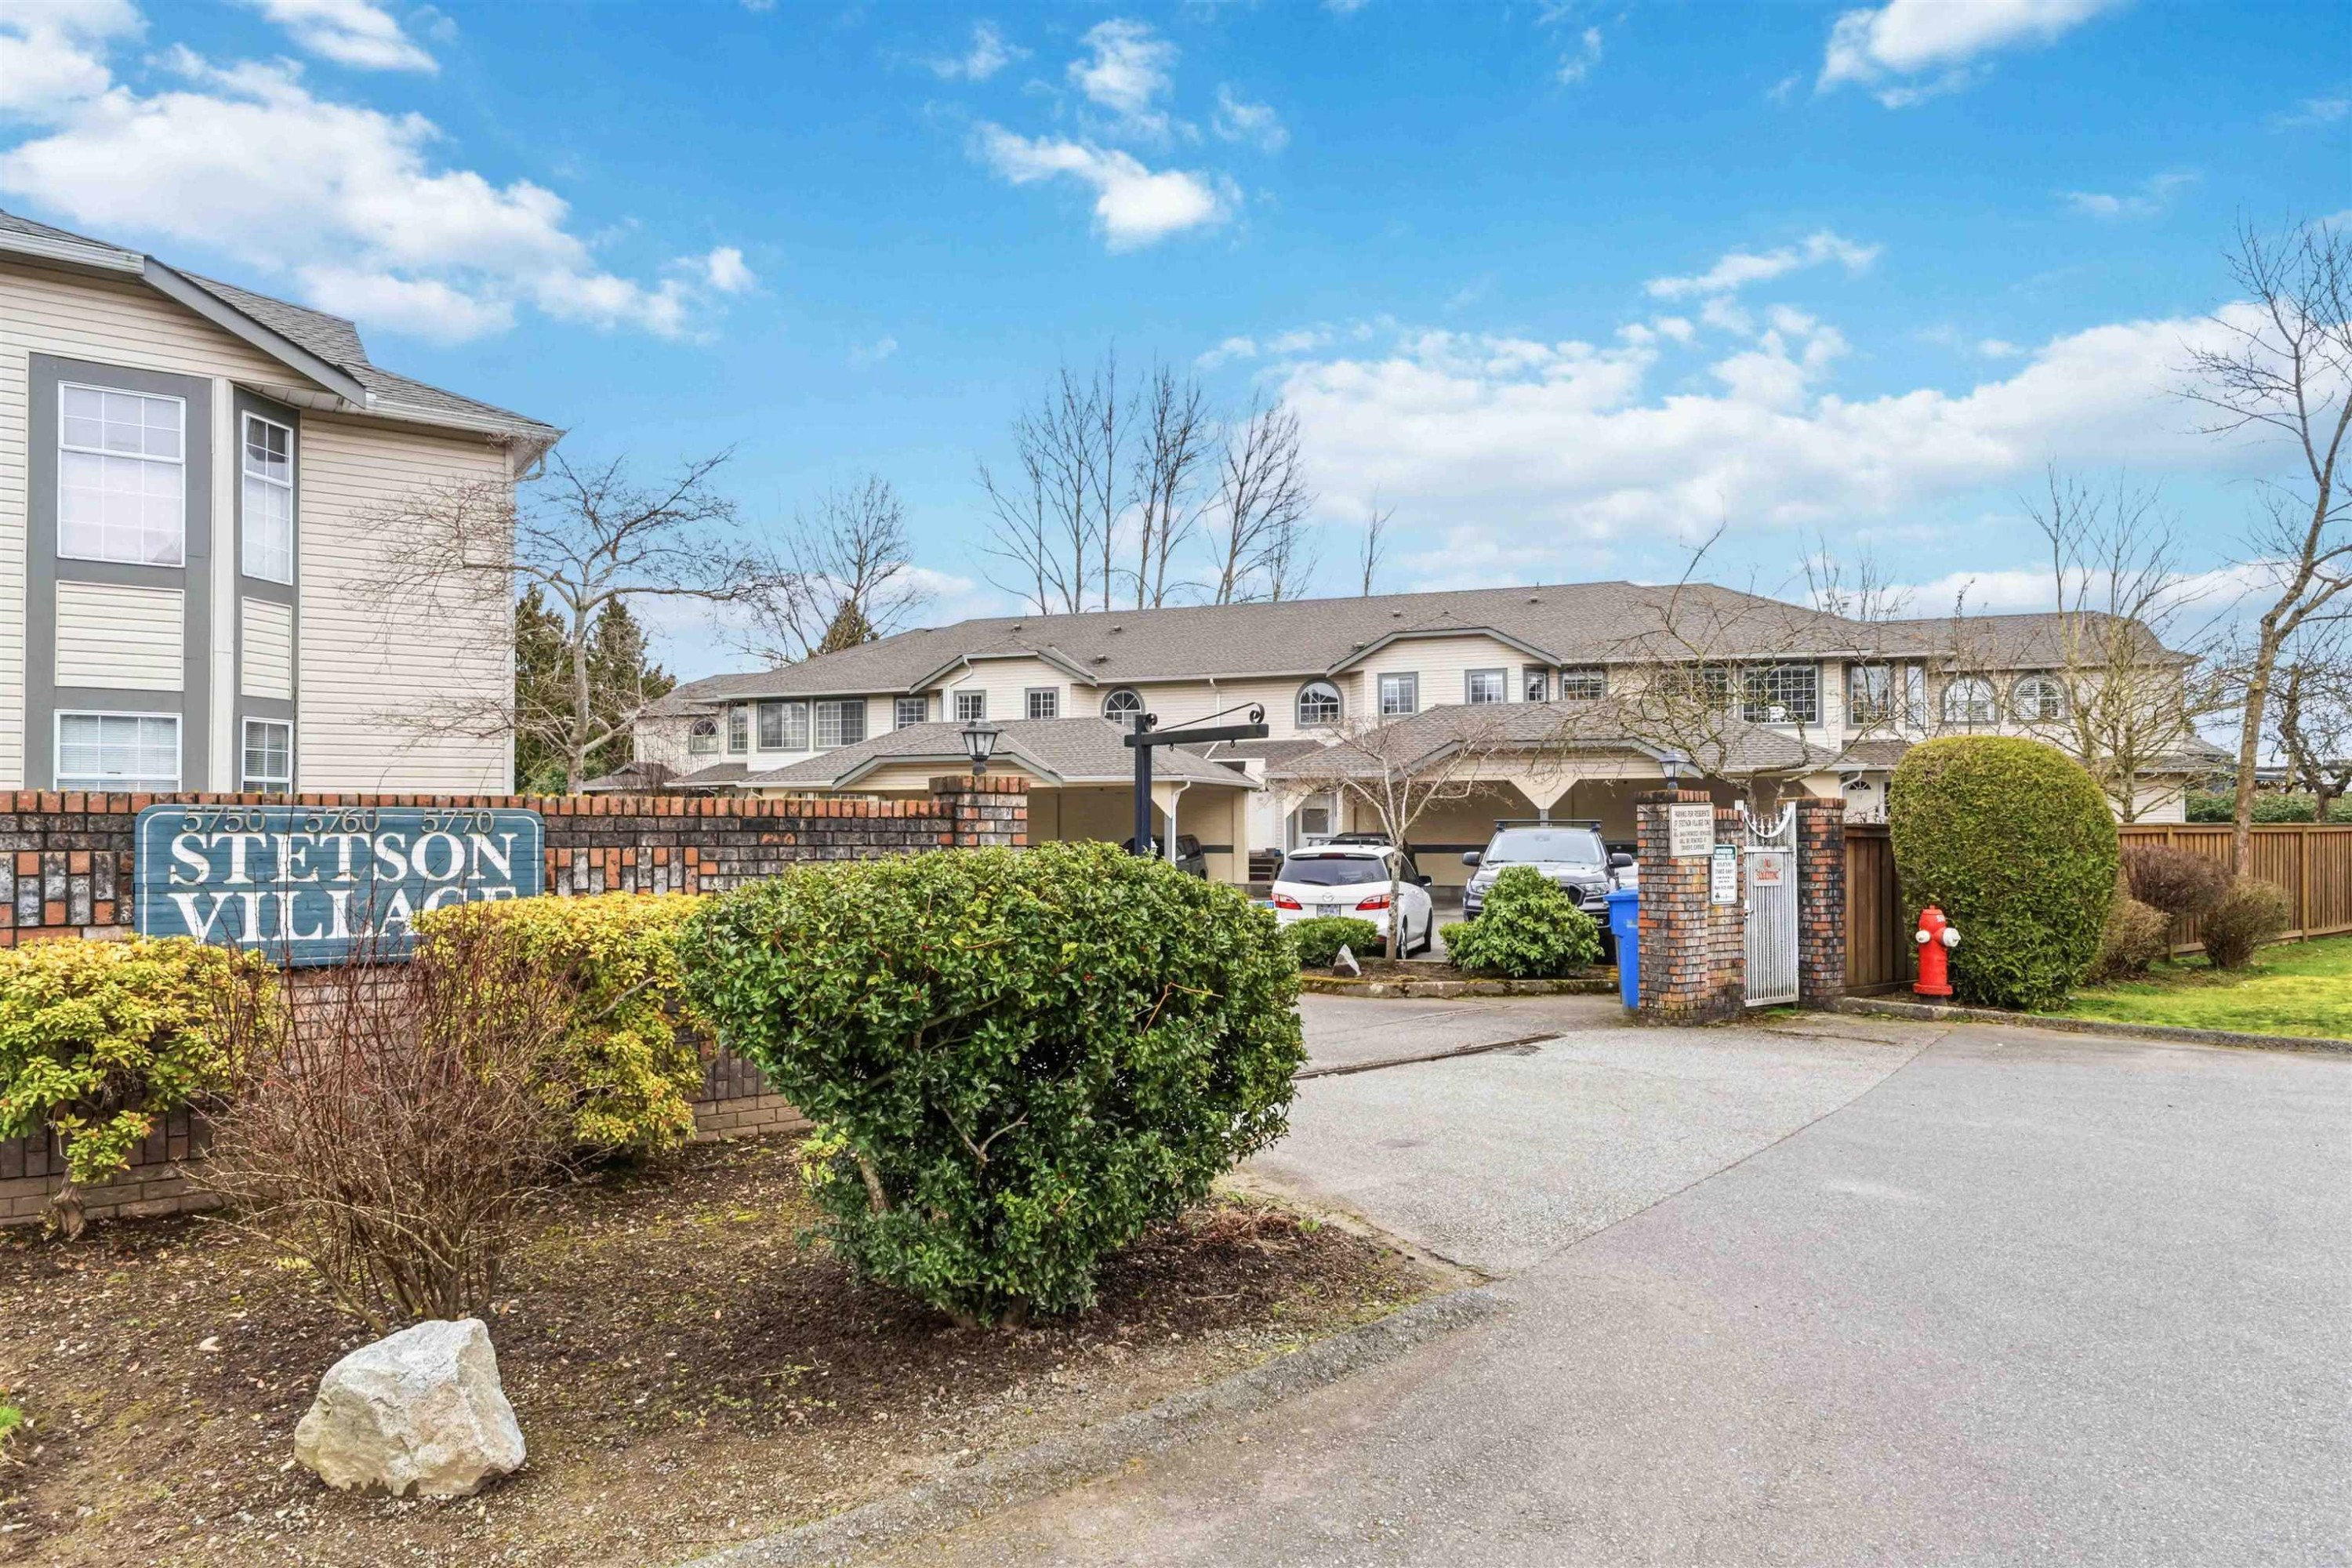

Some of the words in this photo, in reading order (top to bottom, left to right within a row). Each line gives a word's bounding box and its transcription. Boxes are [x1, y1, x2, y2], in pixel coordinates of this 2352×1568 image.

[181, 806, 267, 833] 5750
[304, 808, 381, 834] 5760
[421, 808, 495, 834] 5770
[169, 831, 519, 886] STETSON
[167, 885, 517, 946] VILLA
